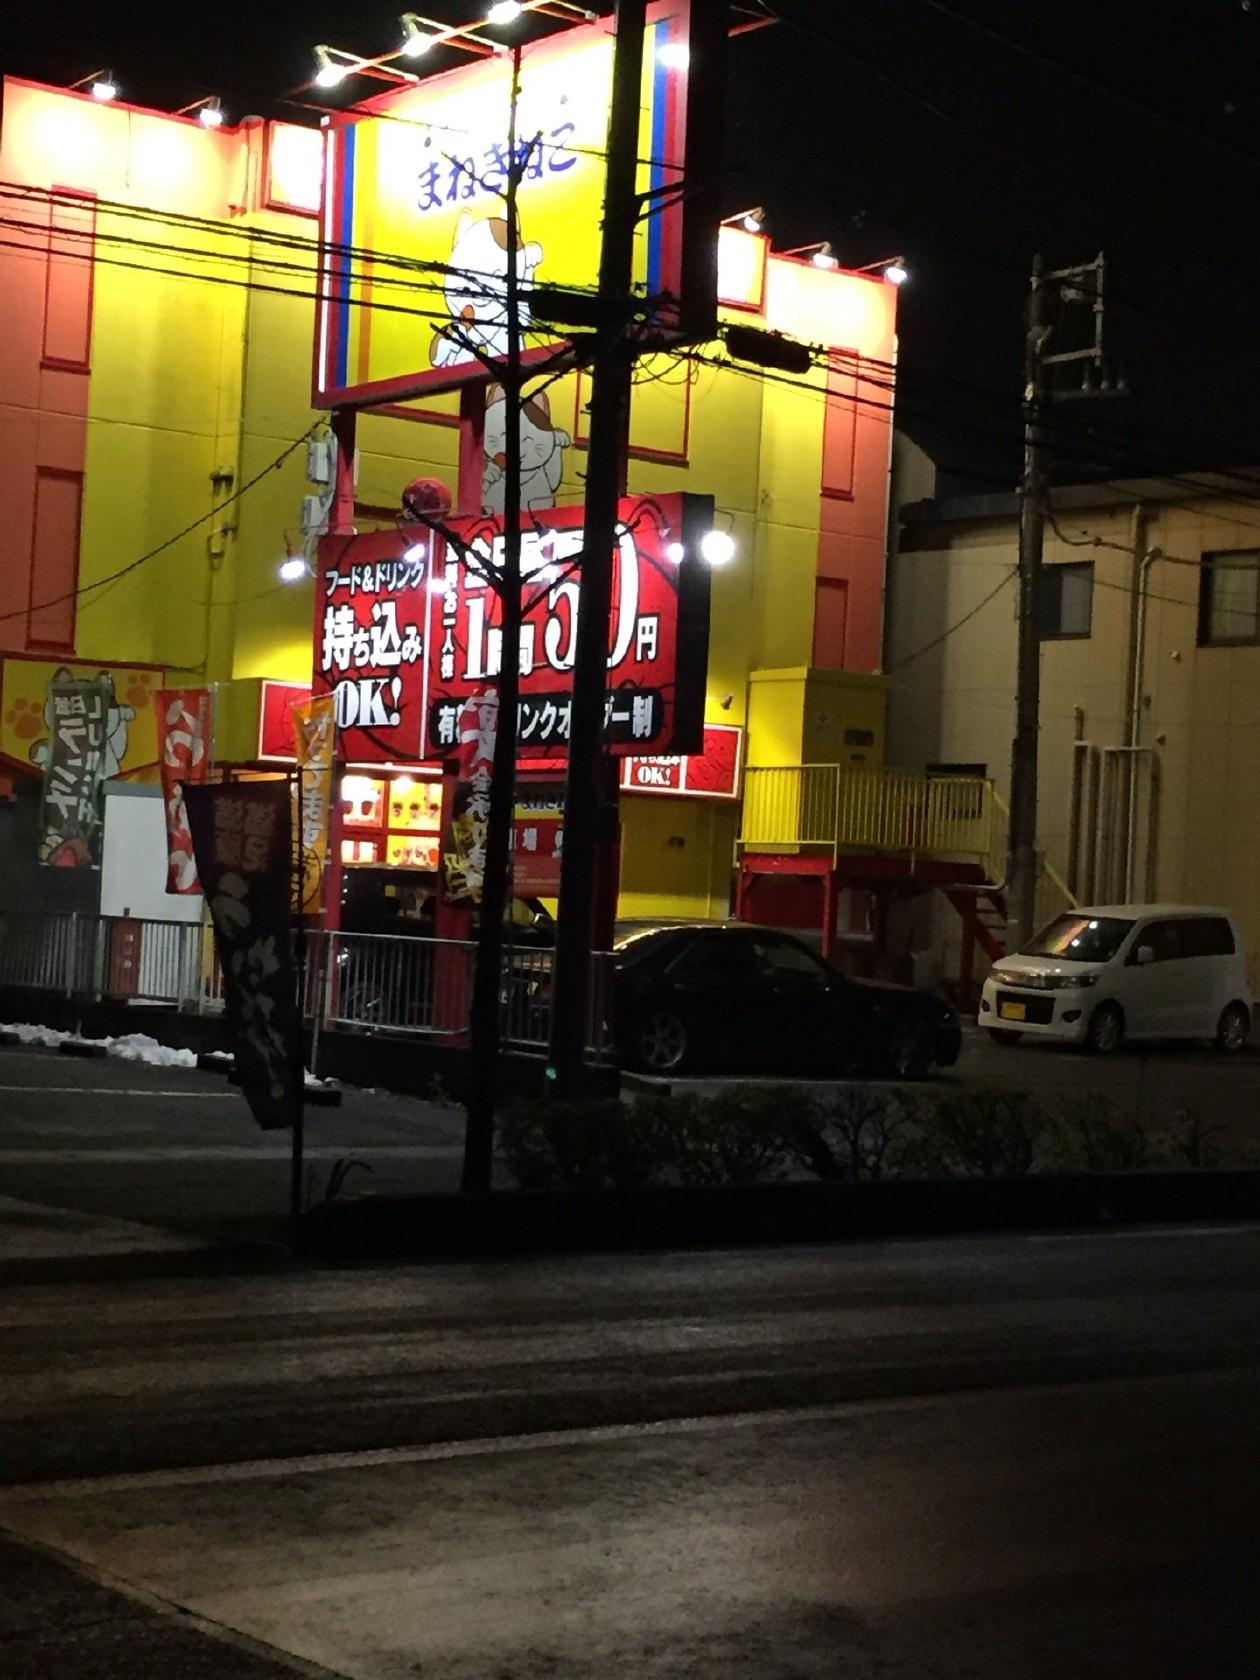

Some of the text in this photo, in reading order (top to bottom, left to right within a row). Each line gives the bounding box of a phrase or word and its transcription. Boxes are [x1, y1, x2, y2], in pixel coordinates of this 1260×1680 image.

[325, 562, 425, 597] フード&ドリンク
[322, 600, 424, 672] 持ち込み
[335, 676, 402, 729] OK!
[637, 766, 671, 786] OK!
